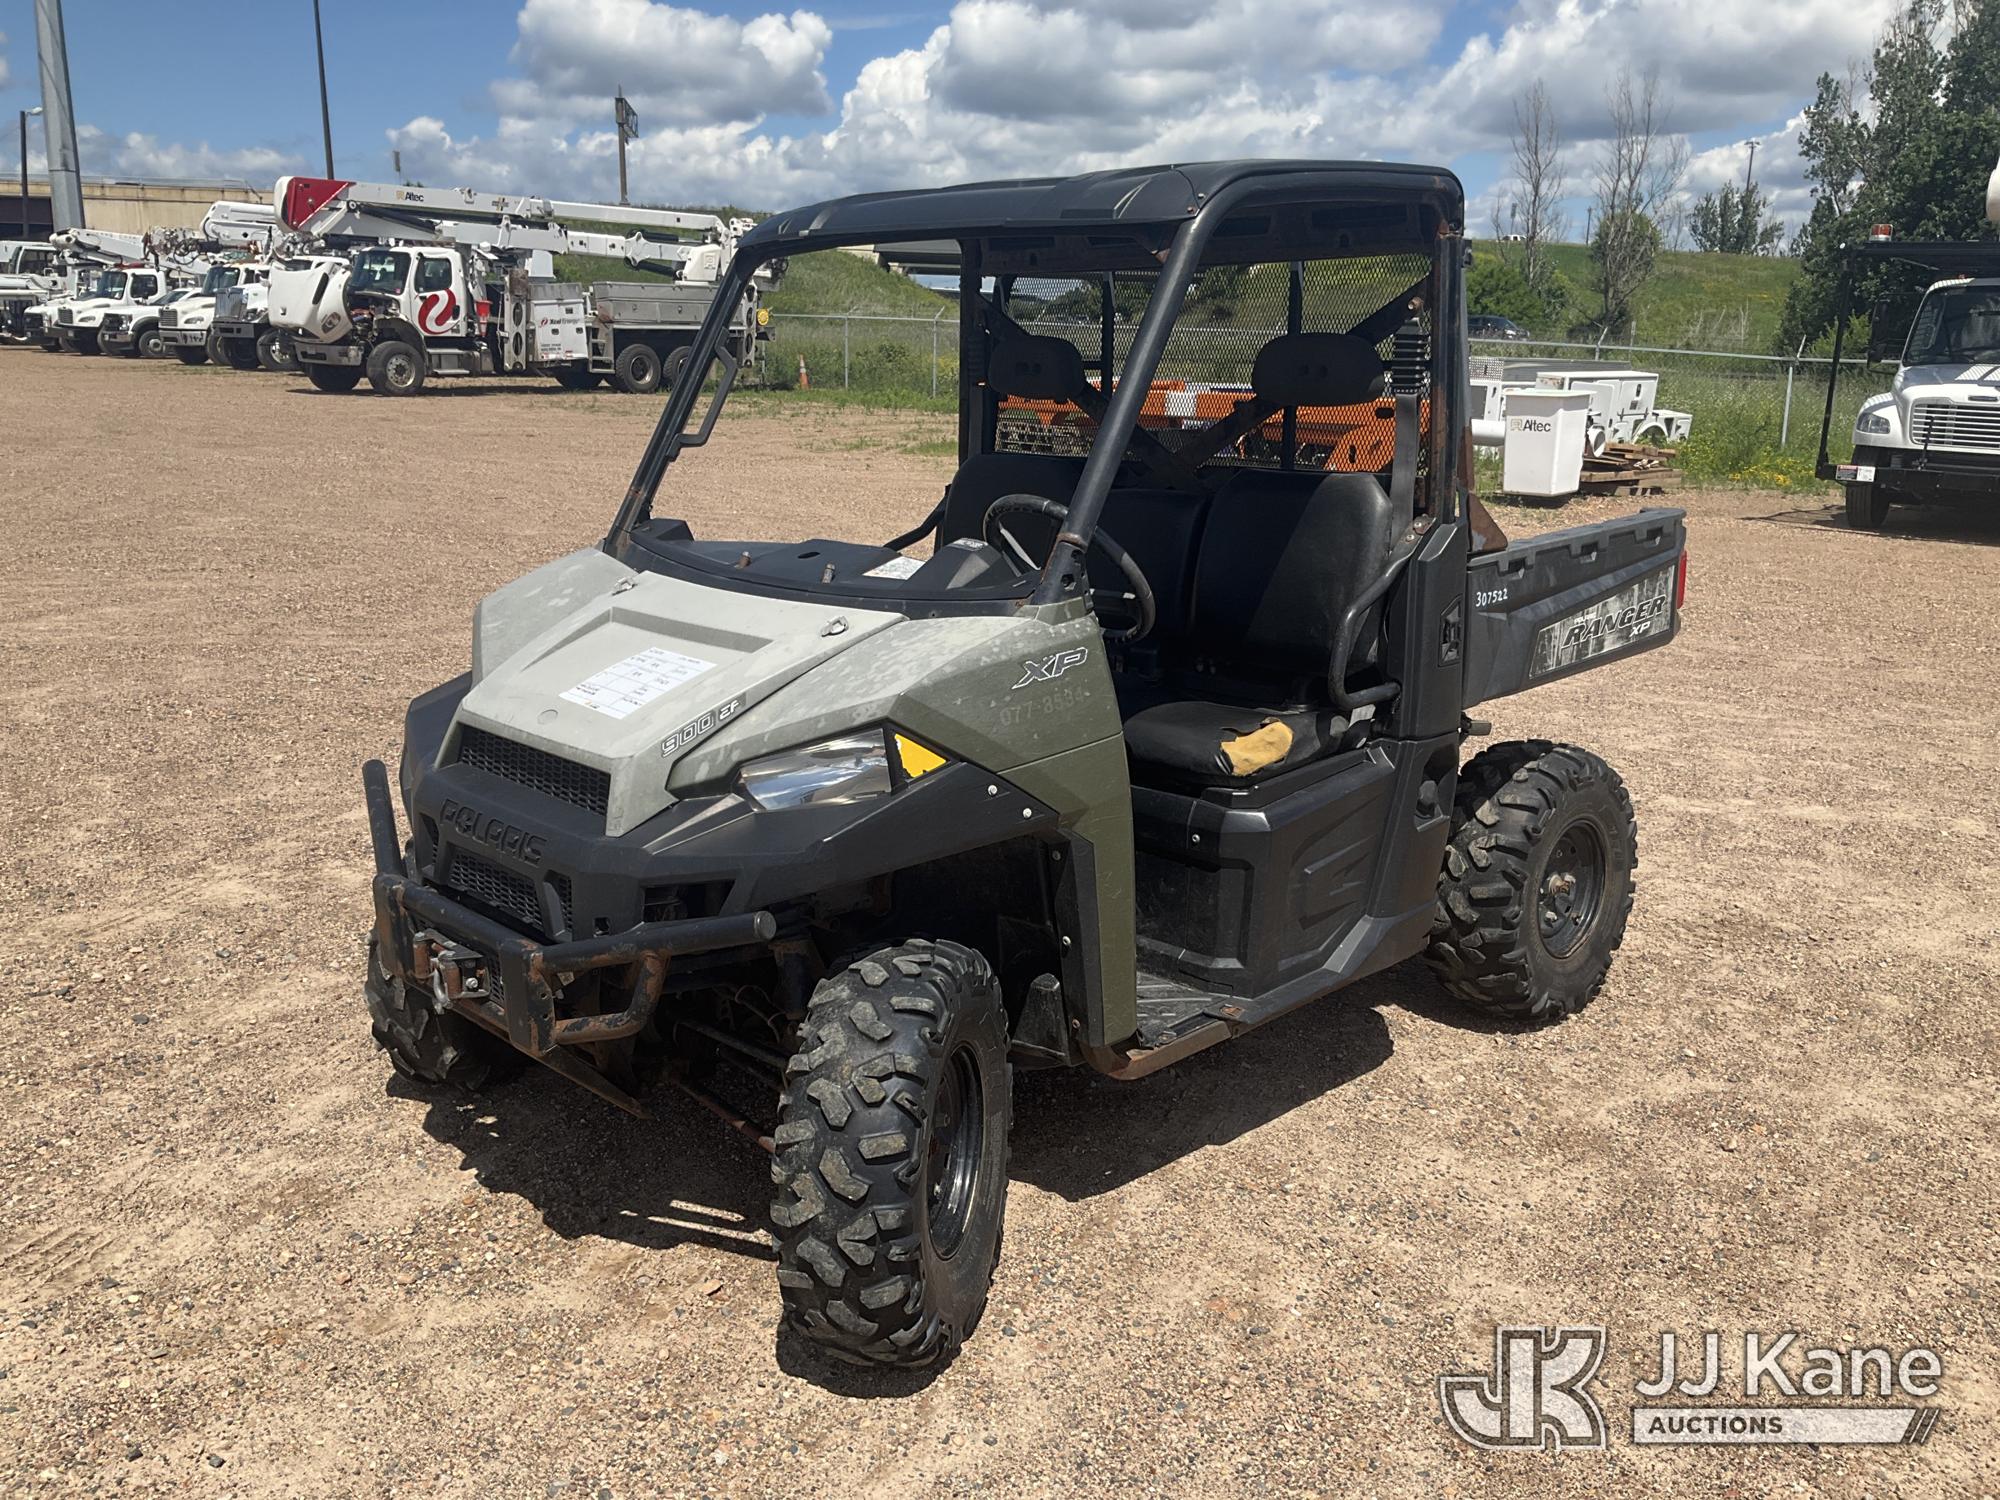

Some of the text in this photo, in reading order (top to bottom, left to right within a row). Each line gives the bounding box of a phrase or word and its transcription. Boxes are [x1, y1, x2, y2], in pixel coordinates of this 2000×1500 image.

[1523, 419, 1551, 433] Altec
[1475, 588, 1508, 607] 307522
[1560, 594, 1666, 650] RANGER
[1628, 621, 1651, 638] XP
[1011, 646, 1088, 690] XP
[662, 699, 740, 757] 900 EF
[440, 798, 548, 868] POLARIS
